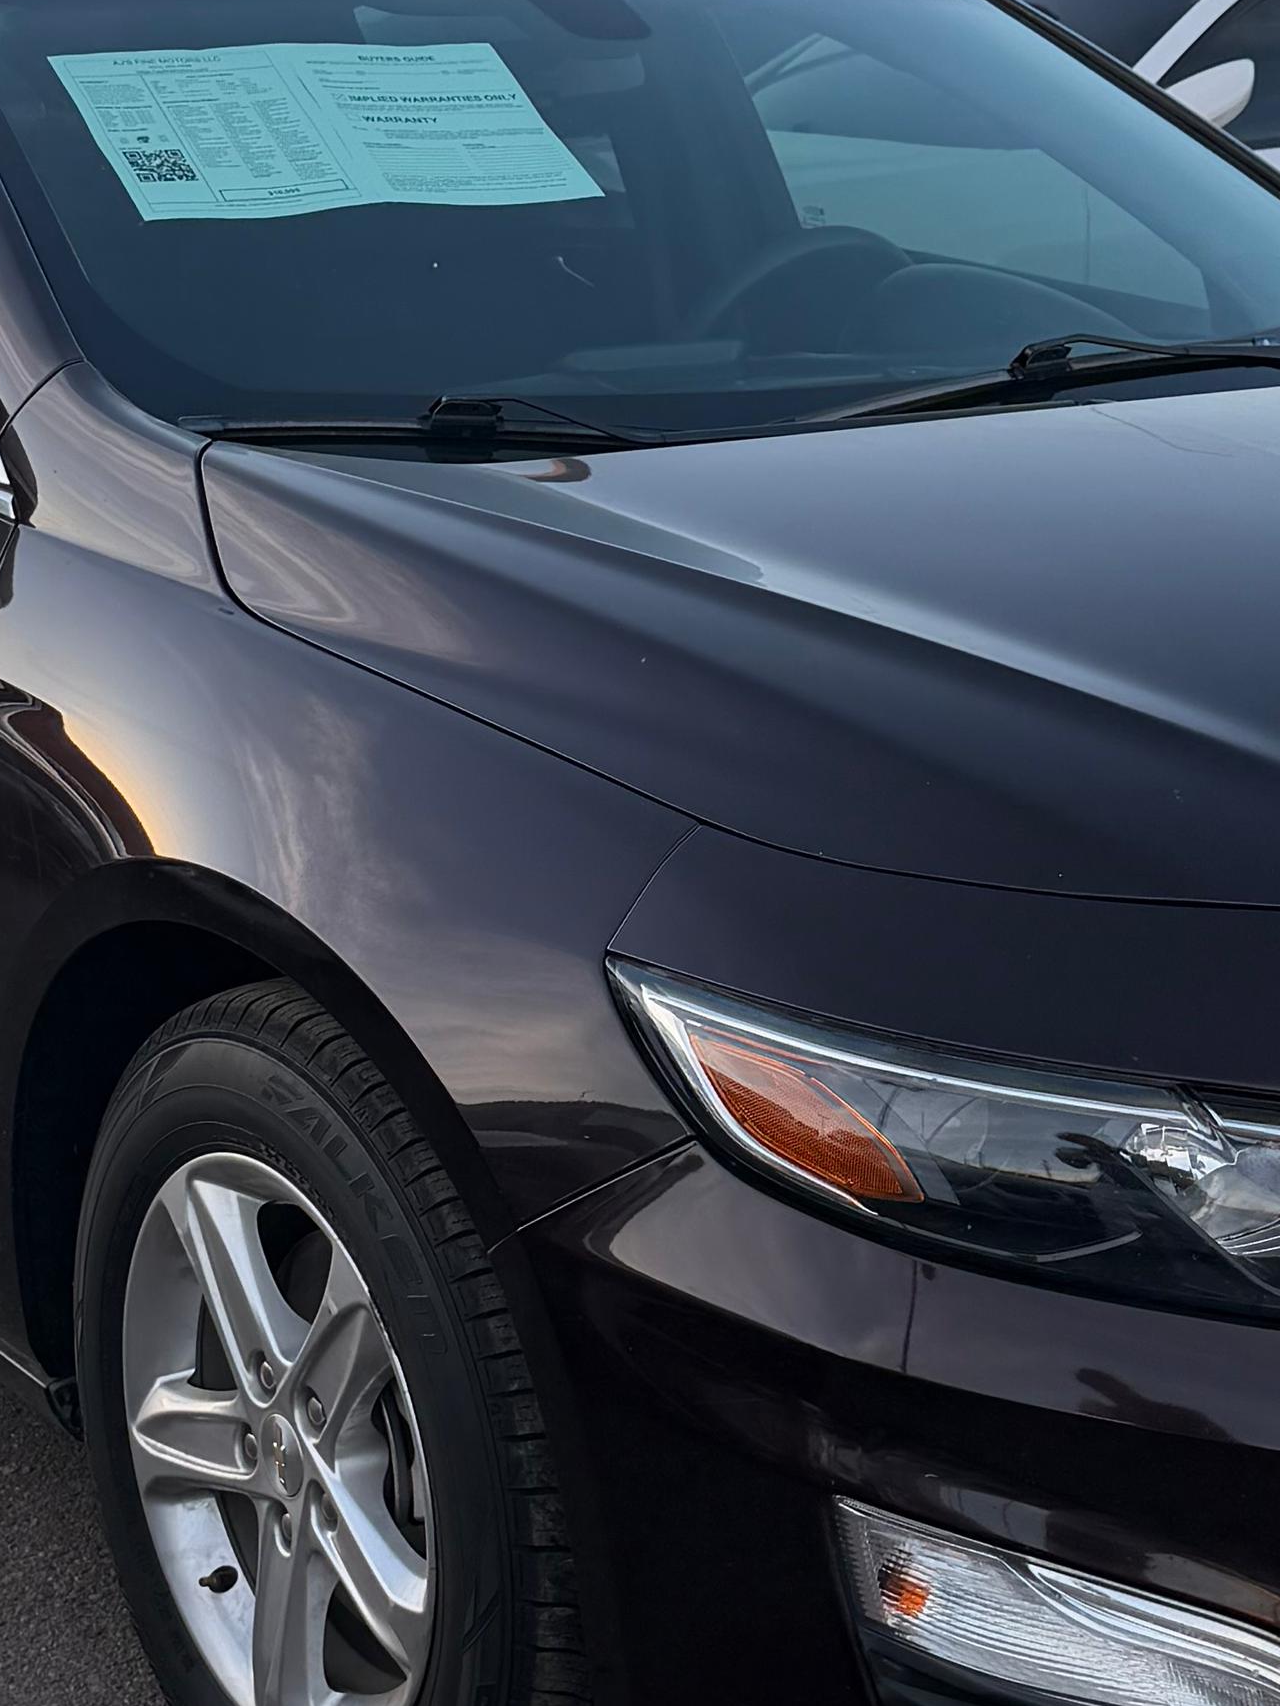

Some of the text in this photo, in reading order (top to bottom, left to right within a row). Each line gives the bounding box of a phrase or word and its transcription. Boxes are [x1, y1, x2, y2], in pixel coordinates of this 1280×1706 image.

[399, 94, 482, 103] WARRANTIES
[483, 93, 517, 101] ONLY
[361, 115, 438, 124] WARRANTY
[260, 1072, 448, 1354] FALKEN
